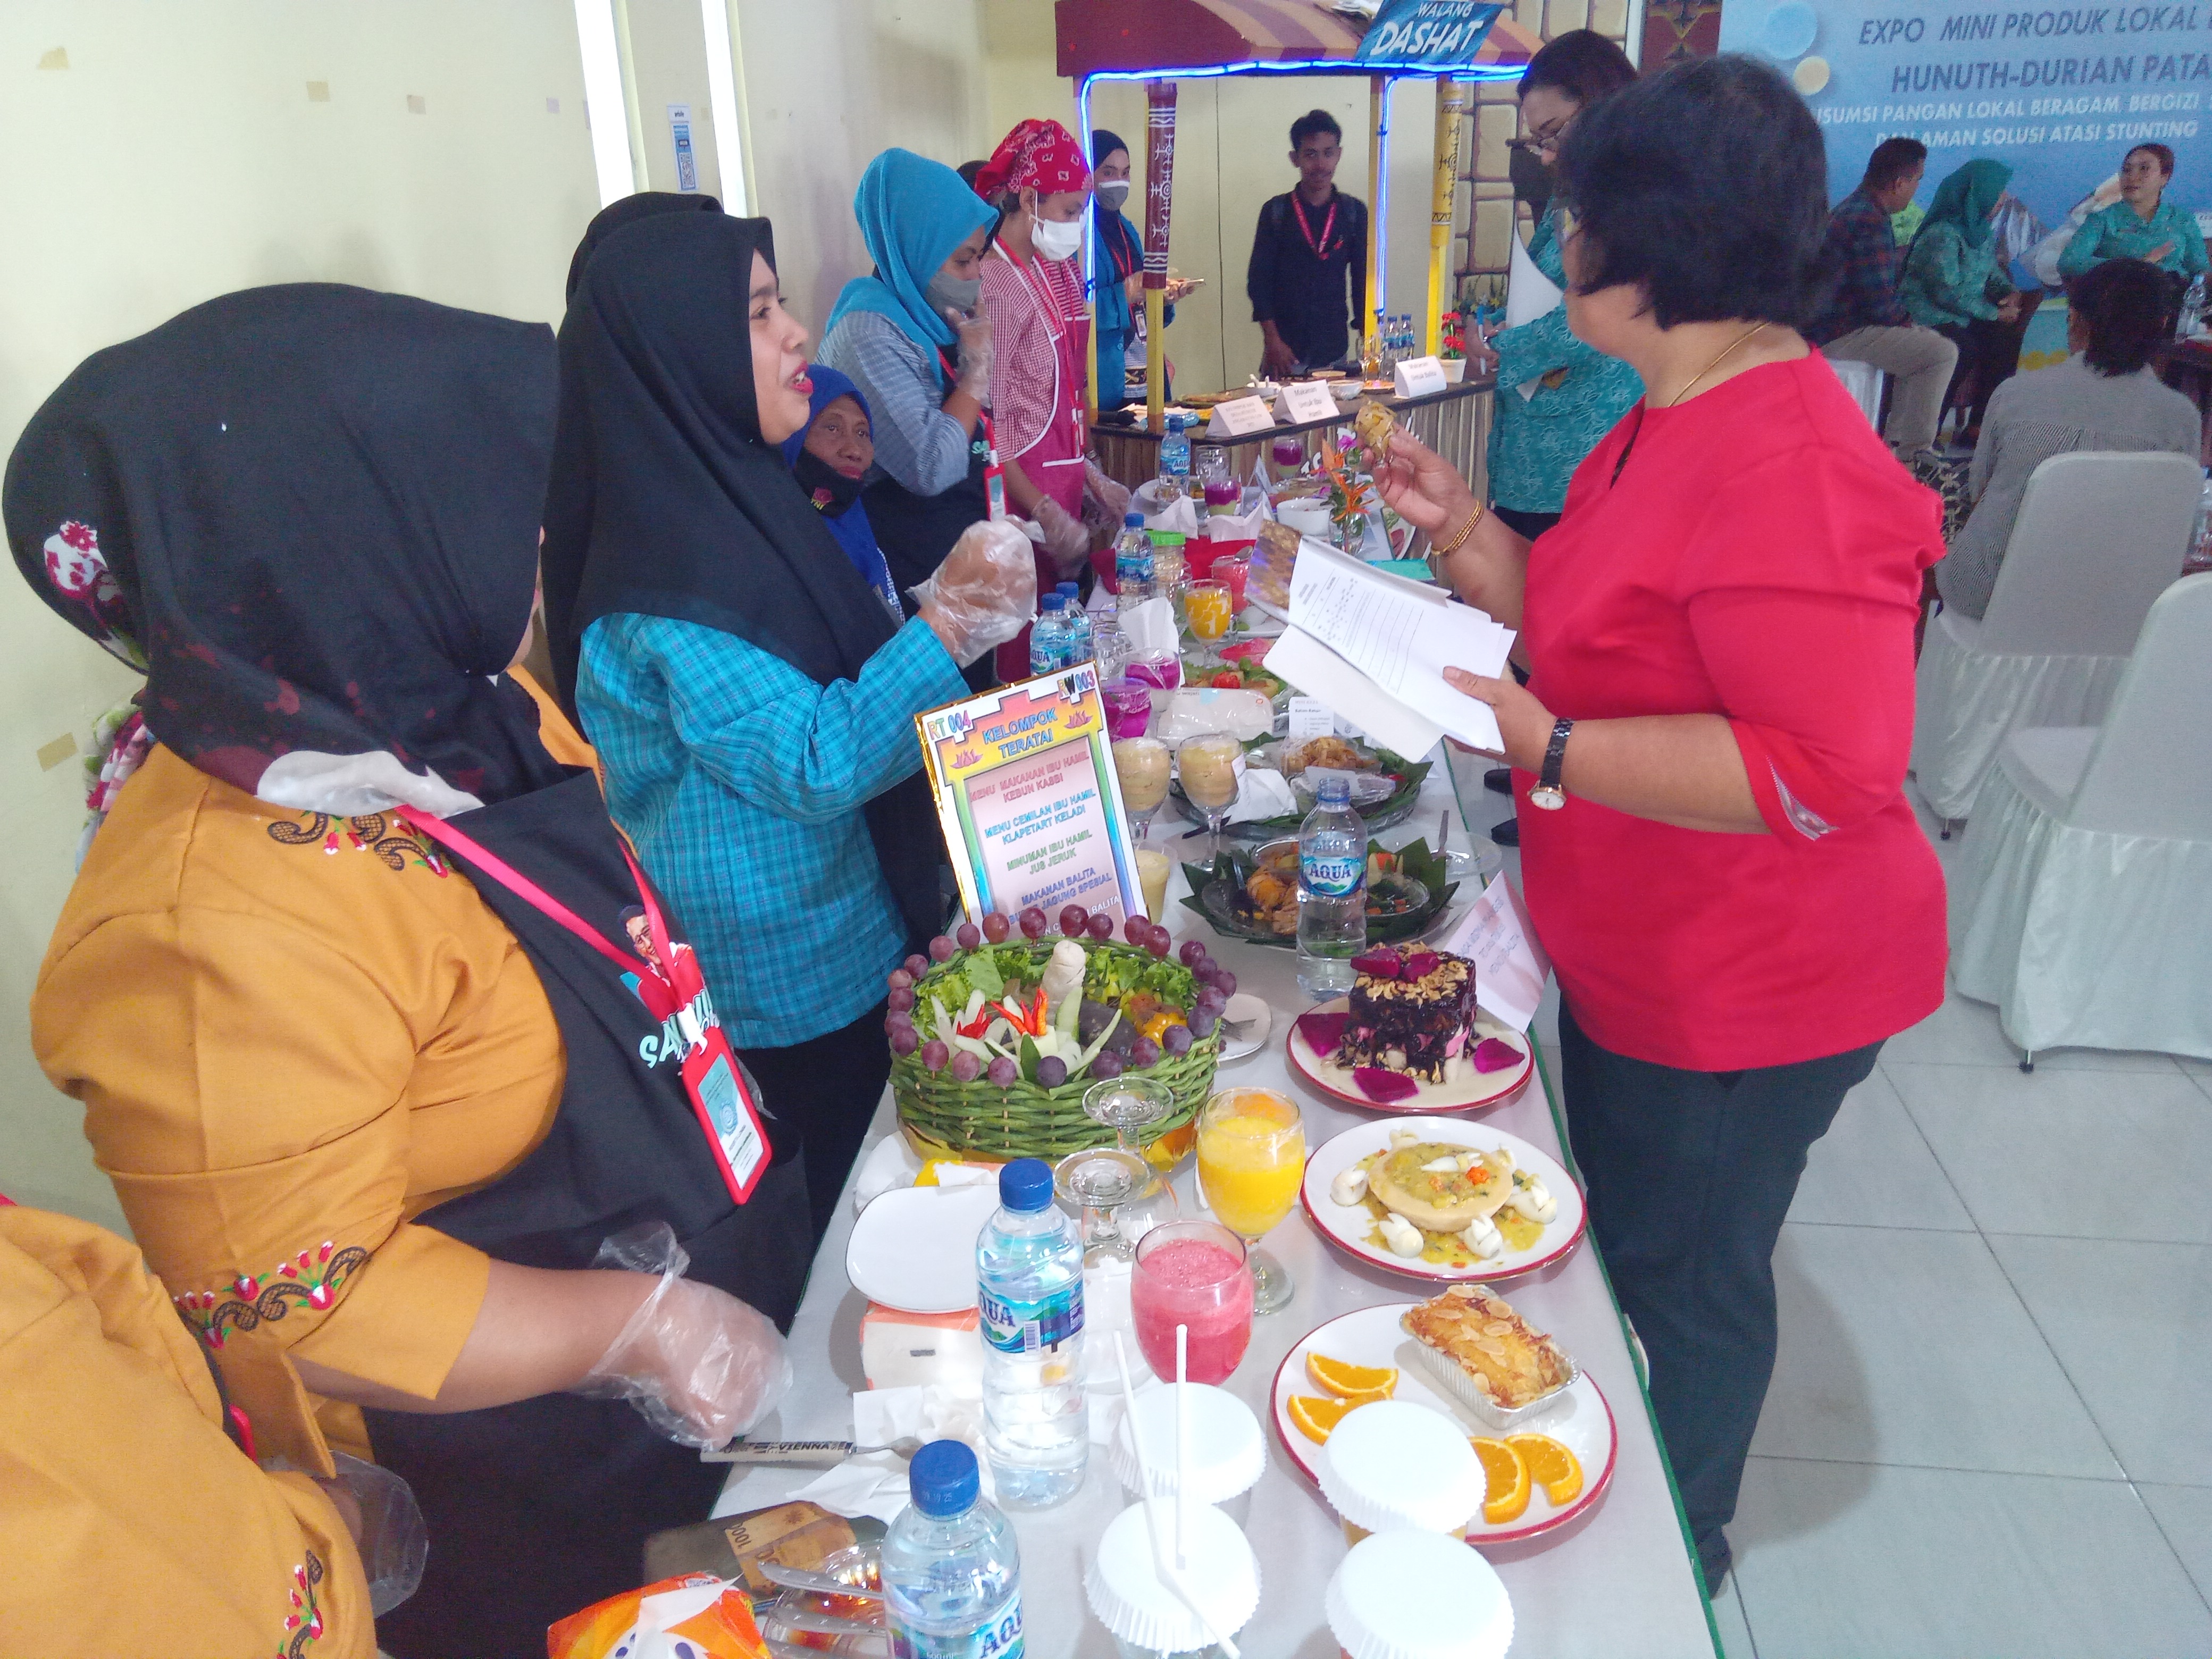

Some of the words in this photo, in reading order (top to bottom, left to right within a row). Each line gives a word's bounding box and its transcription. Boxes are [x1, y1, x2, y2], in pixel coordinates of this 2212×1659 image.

[1418, 2, 1474, 18] WALANG
[1369, 20, 1484, 56] DASHAT
[1859, 18, 1925, 45] EXPO
[1940, 14, 1998, 41] MINI
[2002, 9, 2110, 38] PRODUK
[2115, 6, 2197, 33] LOKAL
[1892, 54, 2136, 93] HUNUTH-DURIAN
[1883, 102, 1963, 122] PANGAN
[1967, 99, 2025, 119] LOKAL
[2031, 96, 2122, 117] BERAGAM
[2129, 93, 2200, 113] BERGIZI
[1981, 124, 2046, 146] SOLUSI
[2050, 122, 2102, 144] ATASI
[2106, 119, 2199, 140] STUNTING
[1075, 669, 1095, 691] 003
[928, 718, 946, 740] RT
[948, 710, 971, 733] 004
[983, 707, 1058, 744] KELOMPOK
[999, 728, 1053, 758] TERATAI
[969, 785, 996, 802] MENU
[1000, 767, 1045, 792] MAKANAN
[1046, 761, 1062, 774] IBU
[1064, 751, 1090, 768] HAMIL
[1003, 784, 1035, 803] KEBUN
[1037, 773, 1064, 791] KASBI
[985, 820, 1011, 839] MENU
[1012, 804, 1052, 827] CEMILAN
[1053, 798, 1069, 811] IBU
[1070, 789, 1096, 806] HAMIL
[1002, 817, 1053, 845] KLAPETART
[1054, 804, 1086, 824] KELADI
[1007, 847, 1048, 871] MINUMAN
[1049, 840, 1065, 854] IBU
[1066, 829, 1093, 847] HAMIL
[1029, 861, 1046, 875] JUS
[1048, 848, 1077, 867] JERUK
[1021, 879, 1065, 906] MAKANAN
[1066, 867, 1096, 886] BALITA
[1310, 863, 1352, 883] AQUA
[1042, 887, 1077, 910] JAGUNG
[1078, 873, 1113, 894] SPESIAL
[1092, 894, 1120, 914] BALITA
[779, 1441, 830, 1451] VIENNA
